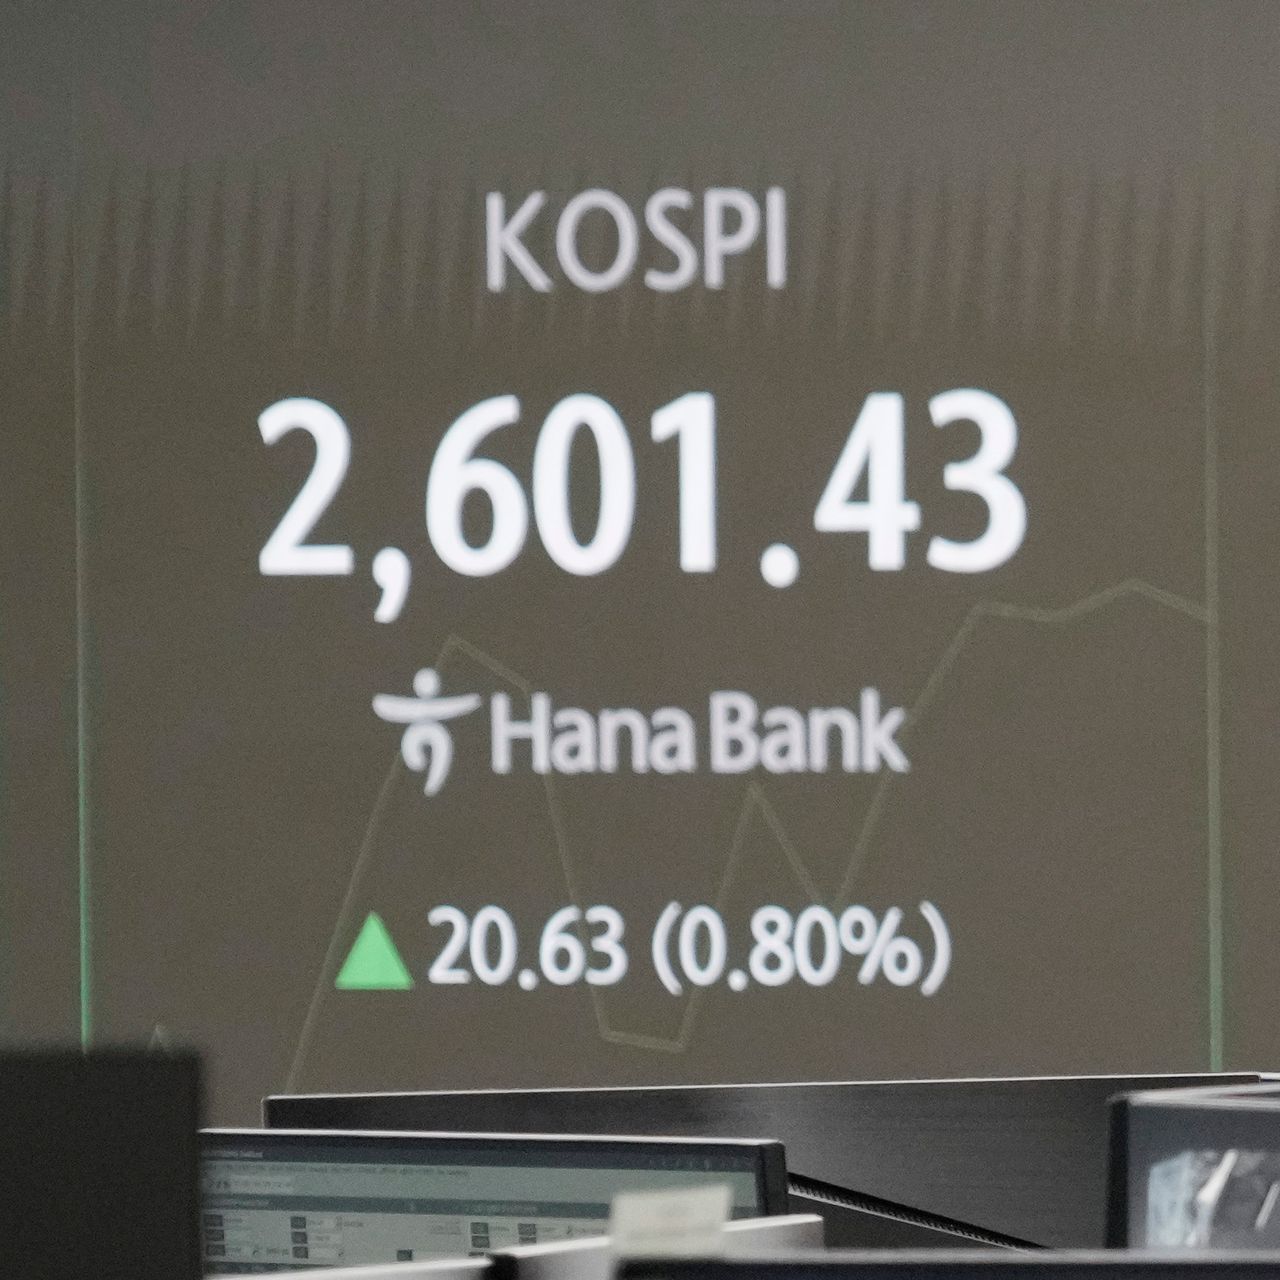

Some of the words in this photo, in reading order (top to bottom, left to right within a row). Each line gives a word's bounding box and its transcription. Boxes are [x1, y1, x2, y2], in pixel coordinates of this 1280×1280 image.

[485, 186, 788, 293] KOSPI
[257, 388, 1028, 624] 2,601.43
[490, 691, 697, 775] Hana
[709, 687, 910, 774] Bank
[428, 905, 628, 992] 20.63
[651, 901, 951, 996] (0.80%)
